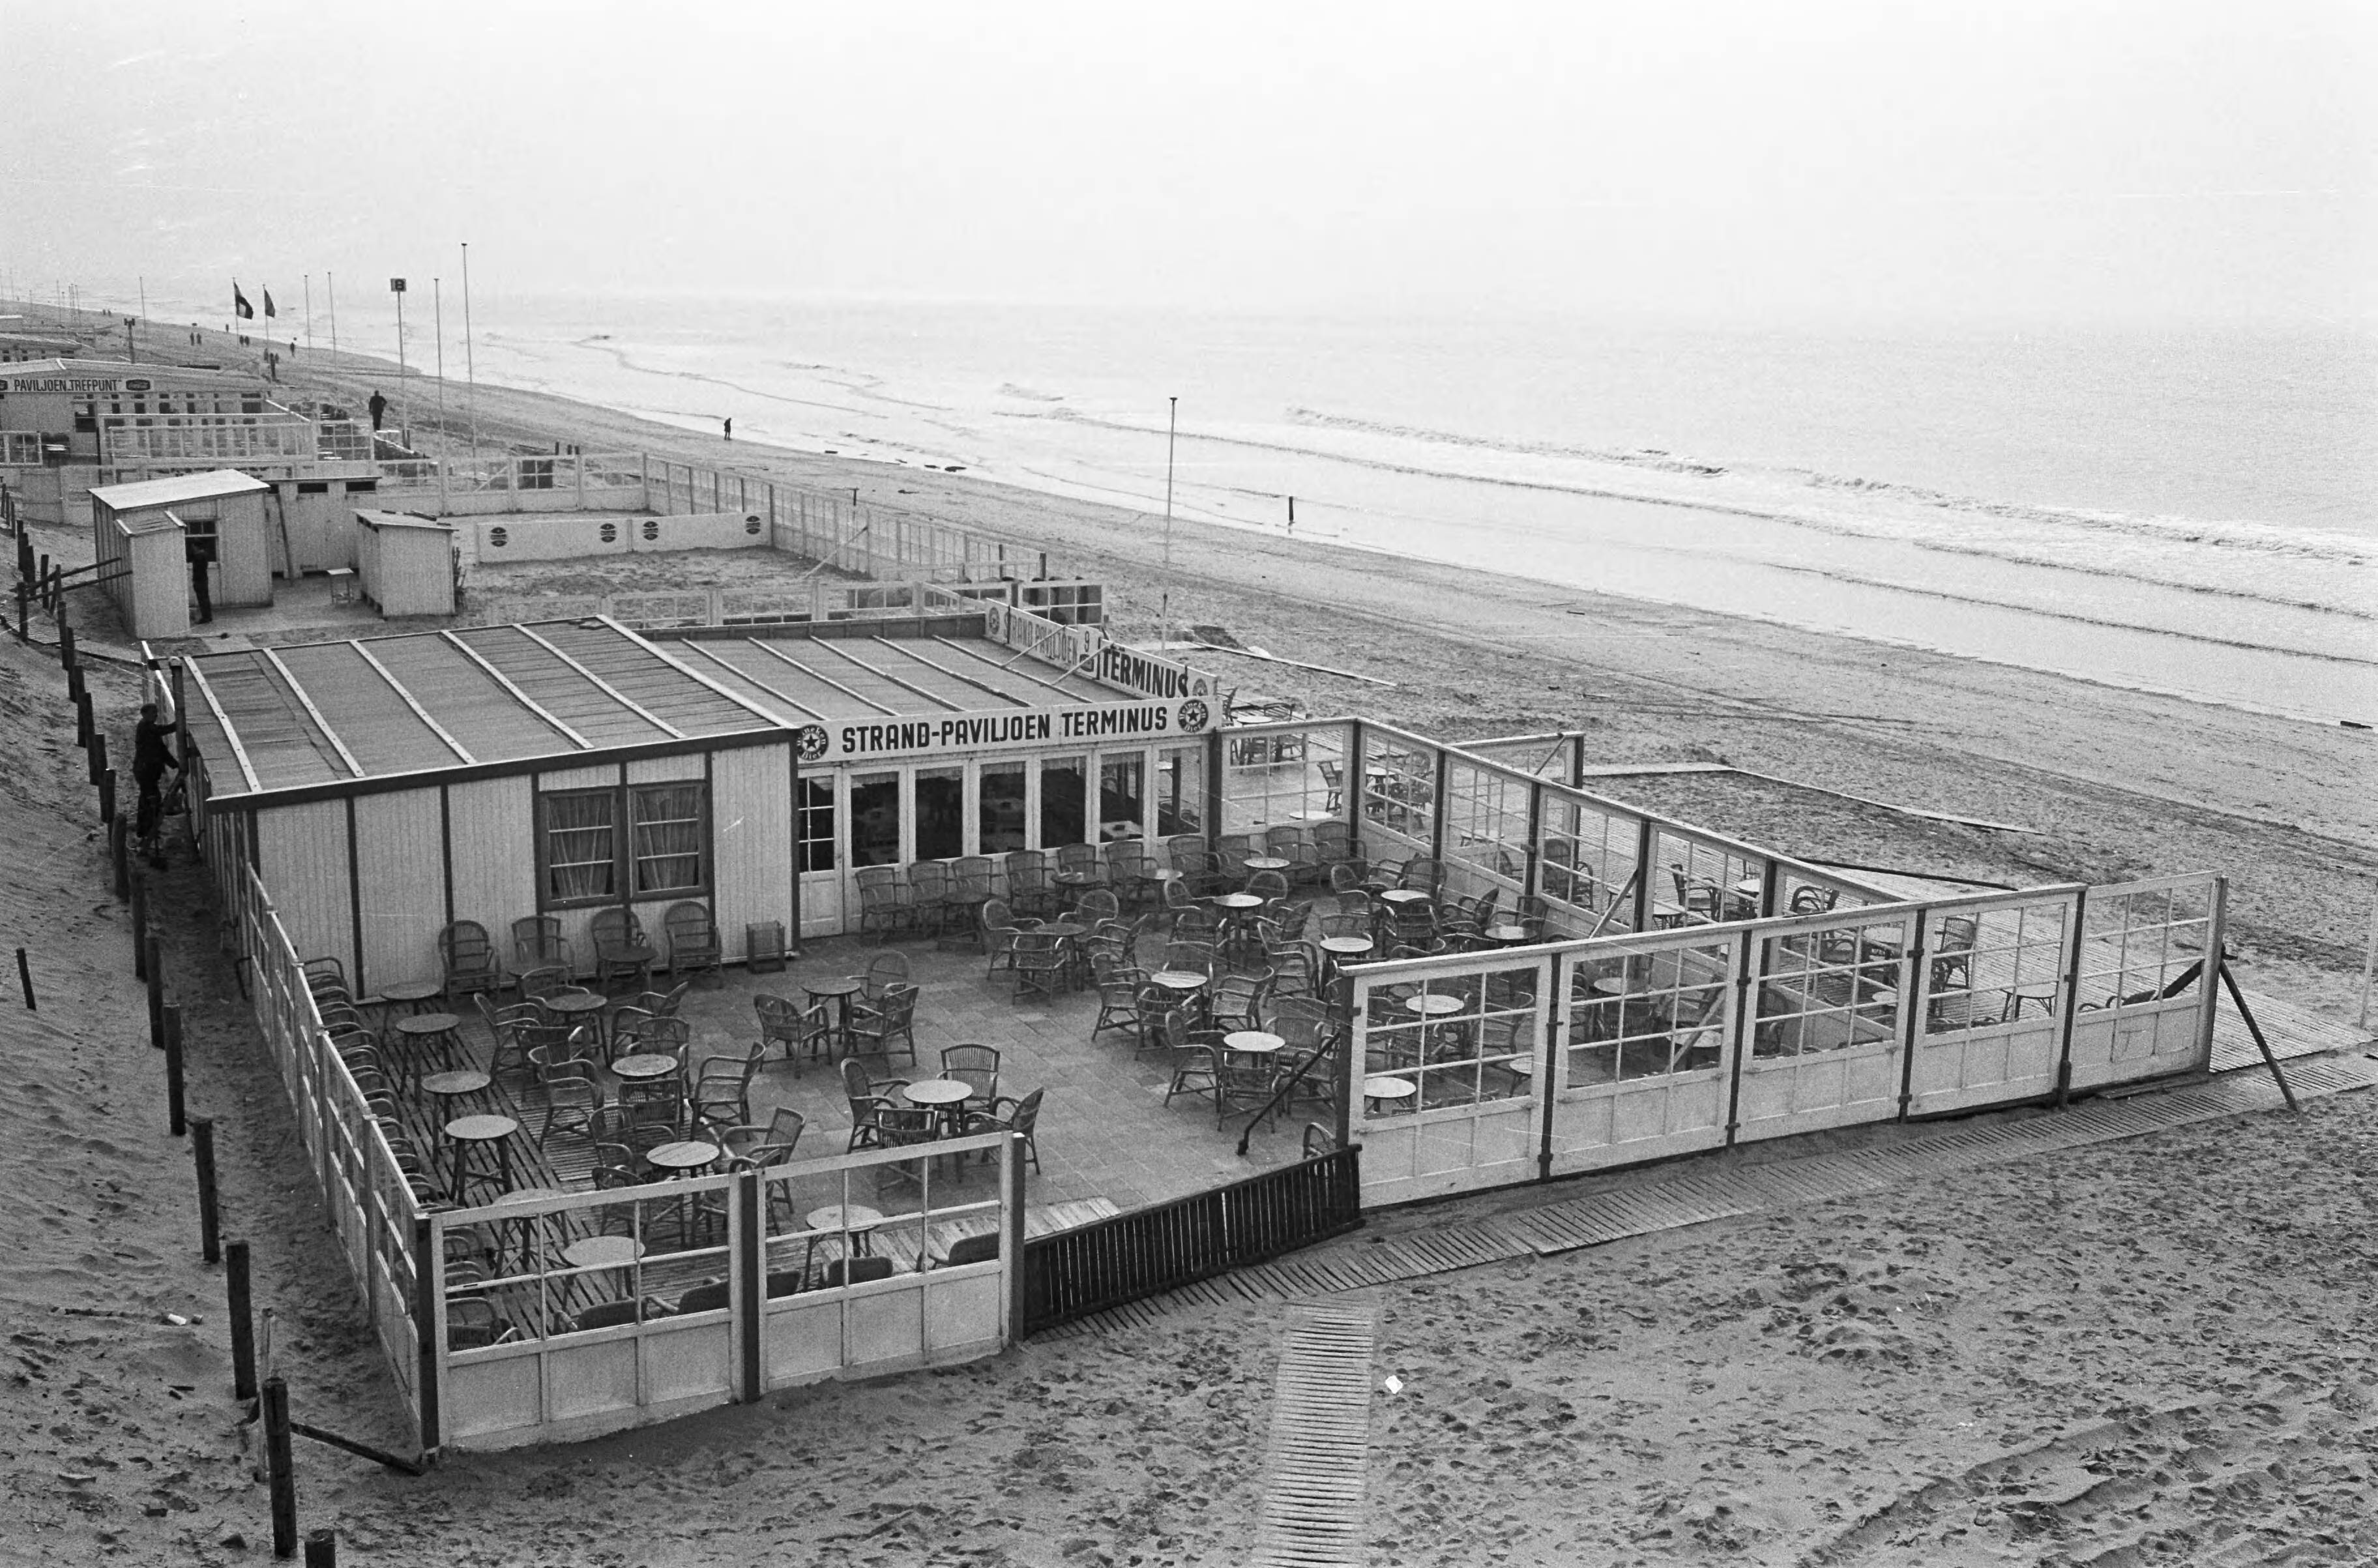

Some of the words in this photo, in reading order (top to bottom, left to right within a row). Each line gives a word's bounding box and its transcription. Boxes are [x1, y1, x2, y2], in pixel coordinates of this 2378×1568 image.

[14, 379, 66, 391] PAVILJOEN
[1103, 648, 1188, 699] TERMINUS
[842, 714, 1050, 753] STRAND-PAVILJOEN
[1061, 706, 1167, 737] TERMINUS
